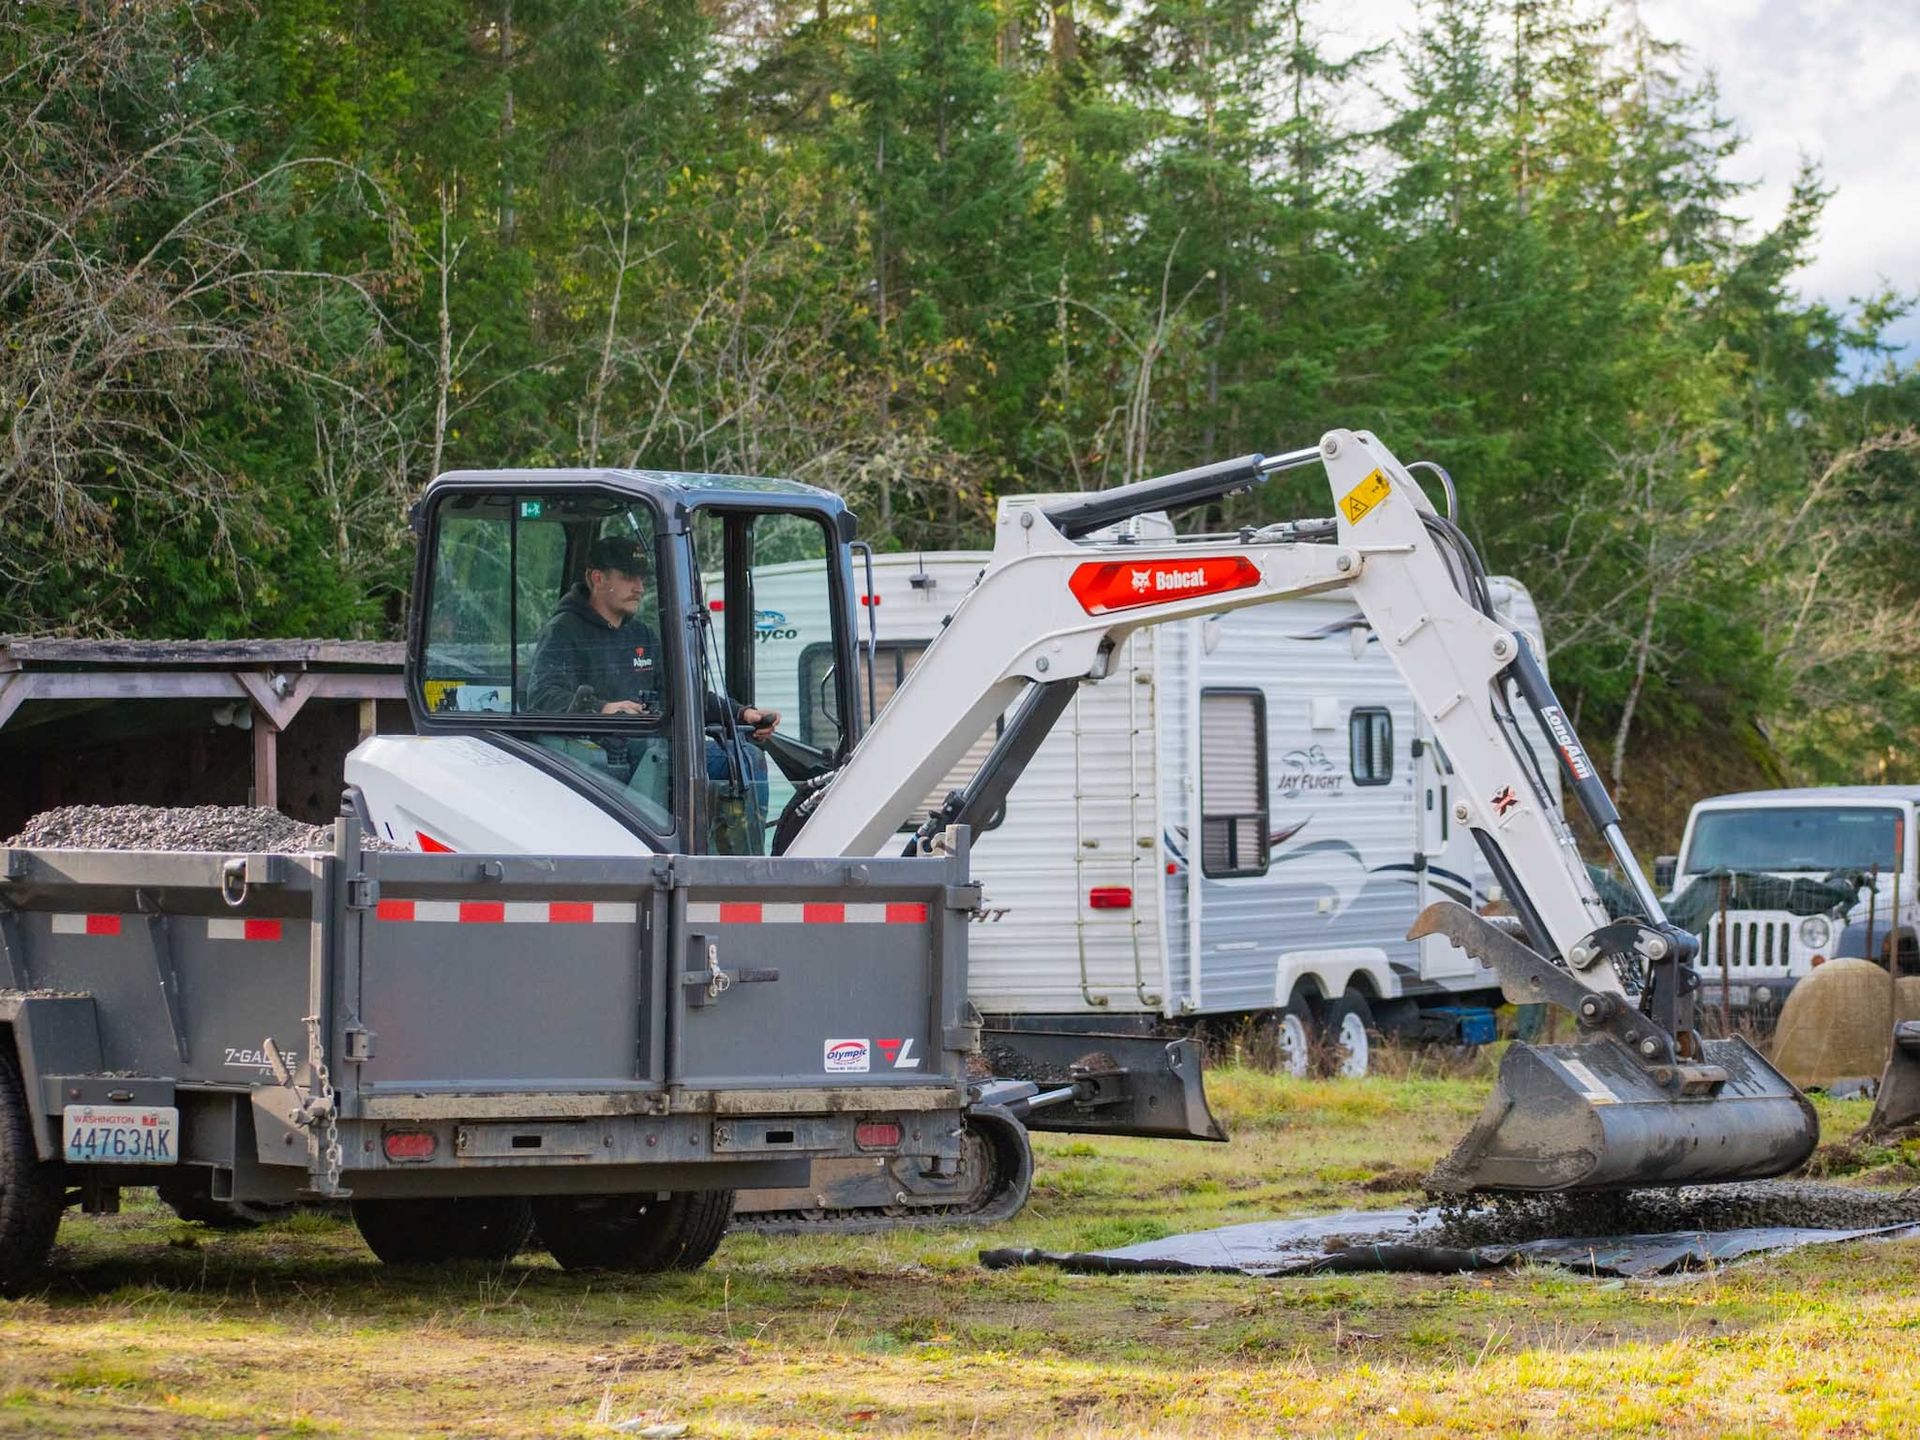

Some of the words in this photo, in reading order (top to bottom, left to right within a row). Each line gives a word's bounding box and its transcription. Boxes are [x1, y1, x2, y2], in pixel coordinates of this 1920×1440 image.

[1156, 567, 1205, 590] Bobcat
[1542, 705, 1590, 779] LongArm
[1277, 775, 1300, 789] JAY
[1301, 774, 1343, 789] FLIGHT
[826, 1048, 867, 1061] Olympic
[73, 1115, 136, 1125] WASHINGTON
[70, 1127, 171, 1157] 44763AK
